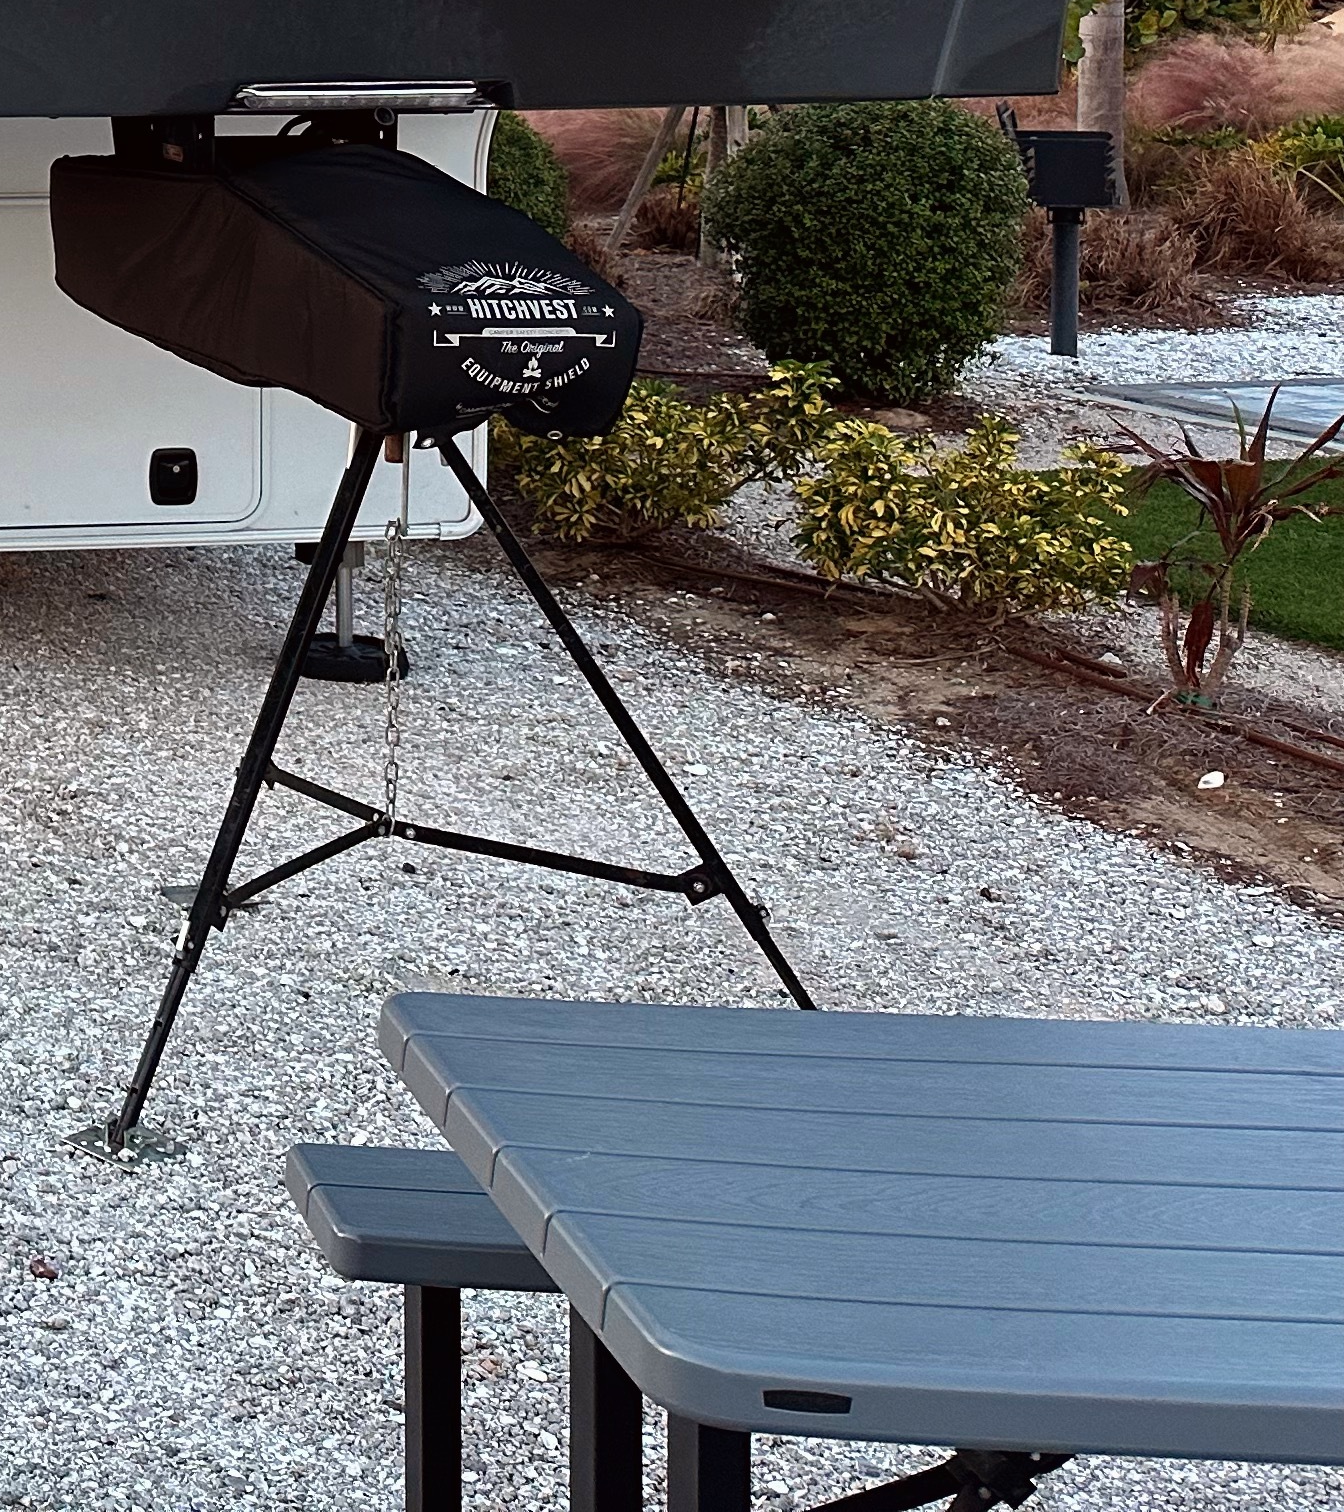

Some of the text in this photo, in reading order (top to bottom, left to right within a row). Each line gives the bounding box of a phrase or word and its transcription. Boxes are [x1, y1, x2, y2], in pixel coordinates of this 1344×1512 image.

[466, 298, 578, 320] HITCHVEST
[500, 341, 564, 358] The Original
[461, 357, 591, 394] EQUIPMENT SHIELD
